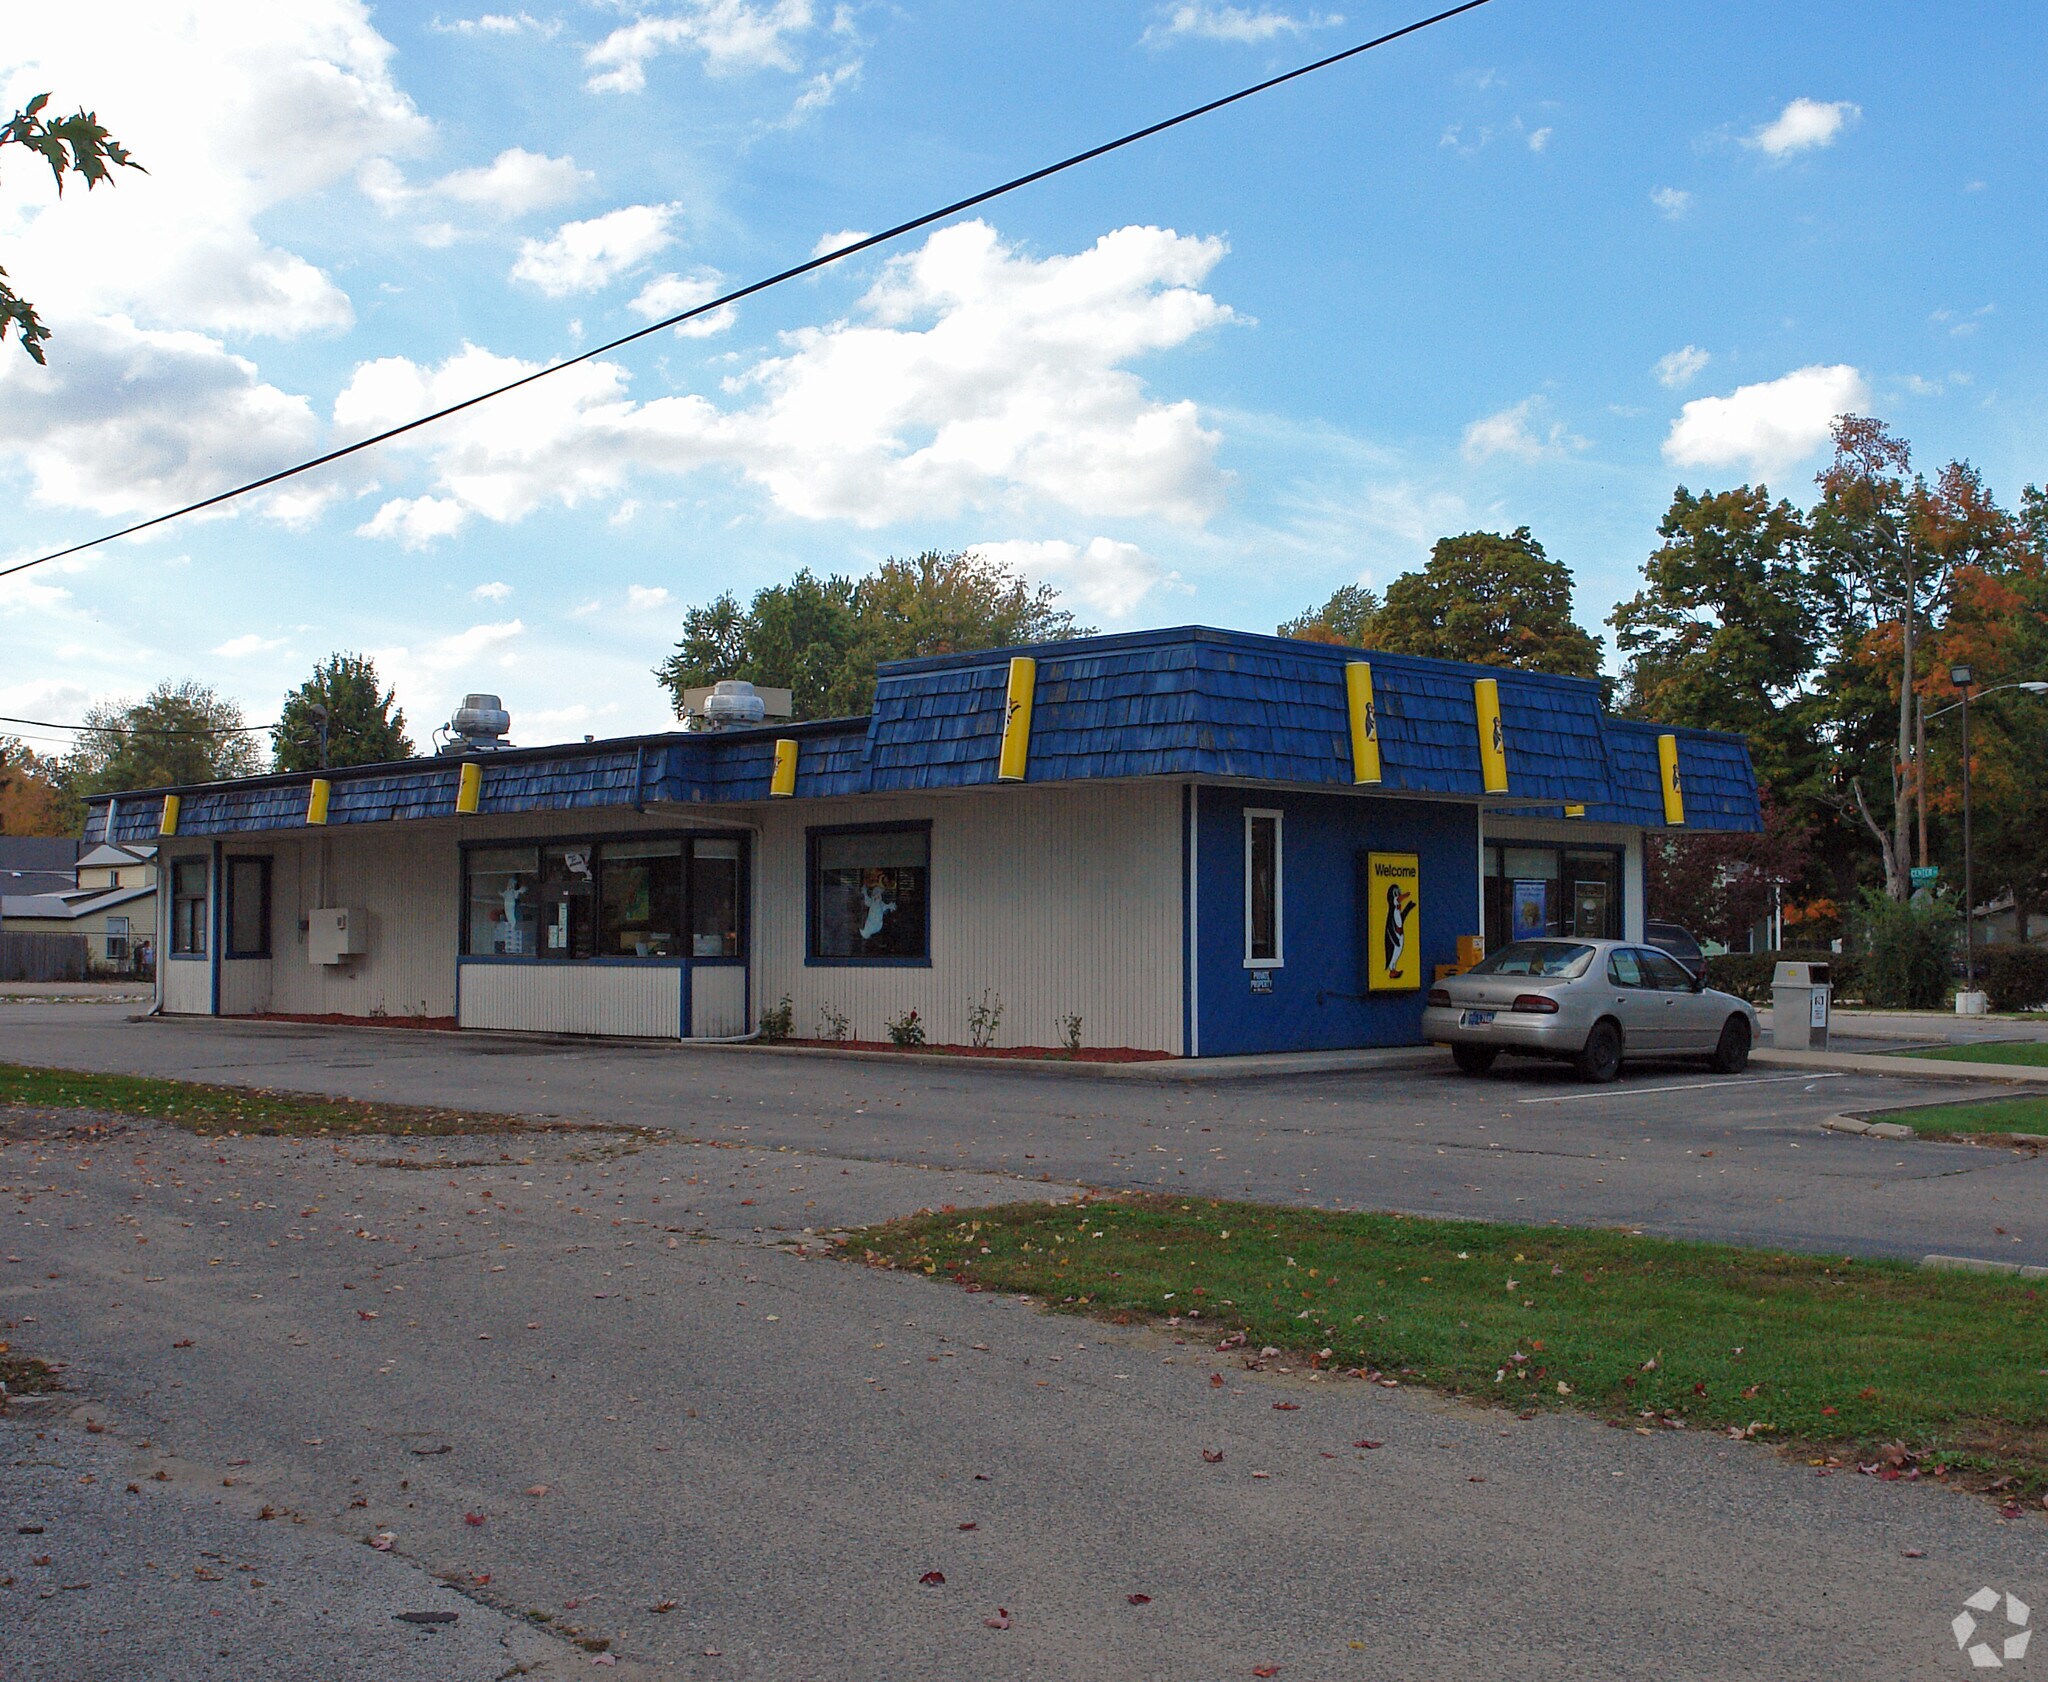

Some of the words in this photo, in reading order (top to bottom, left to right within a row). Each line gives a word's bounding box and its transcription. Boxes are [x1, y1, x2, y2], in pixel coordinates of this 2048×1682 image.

[1375, 864, 1416, 877] Welcome
[1911, 868, 1932, 878] CENTER
[1251, 980, 1272, 988] PROPERTY
